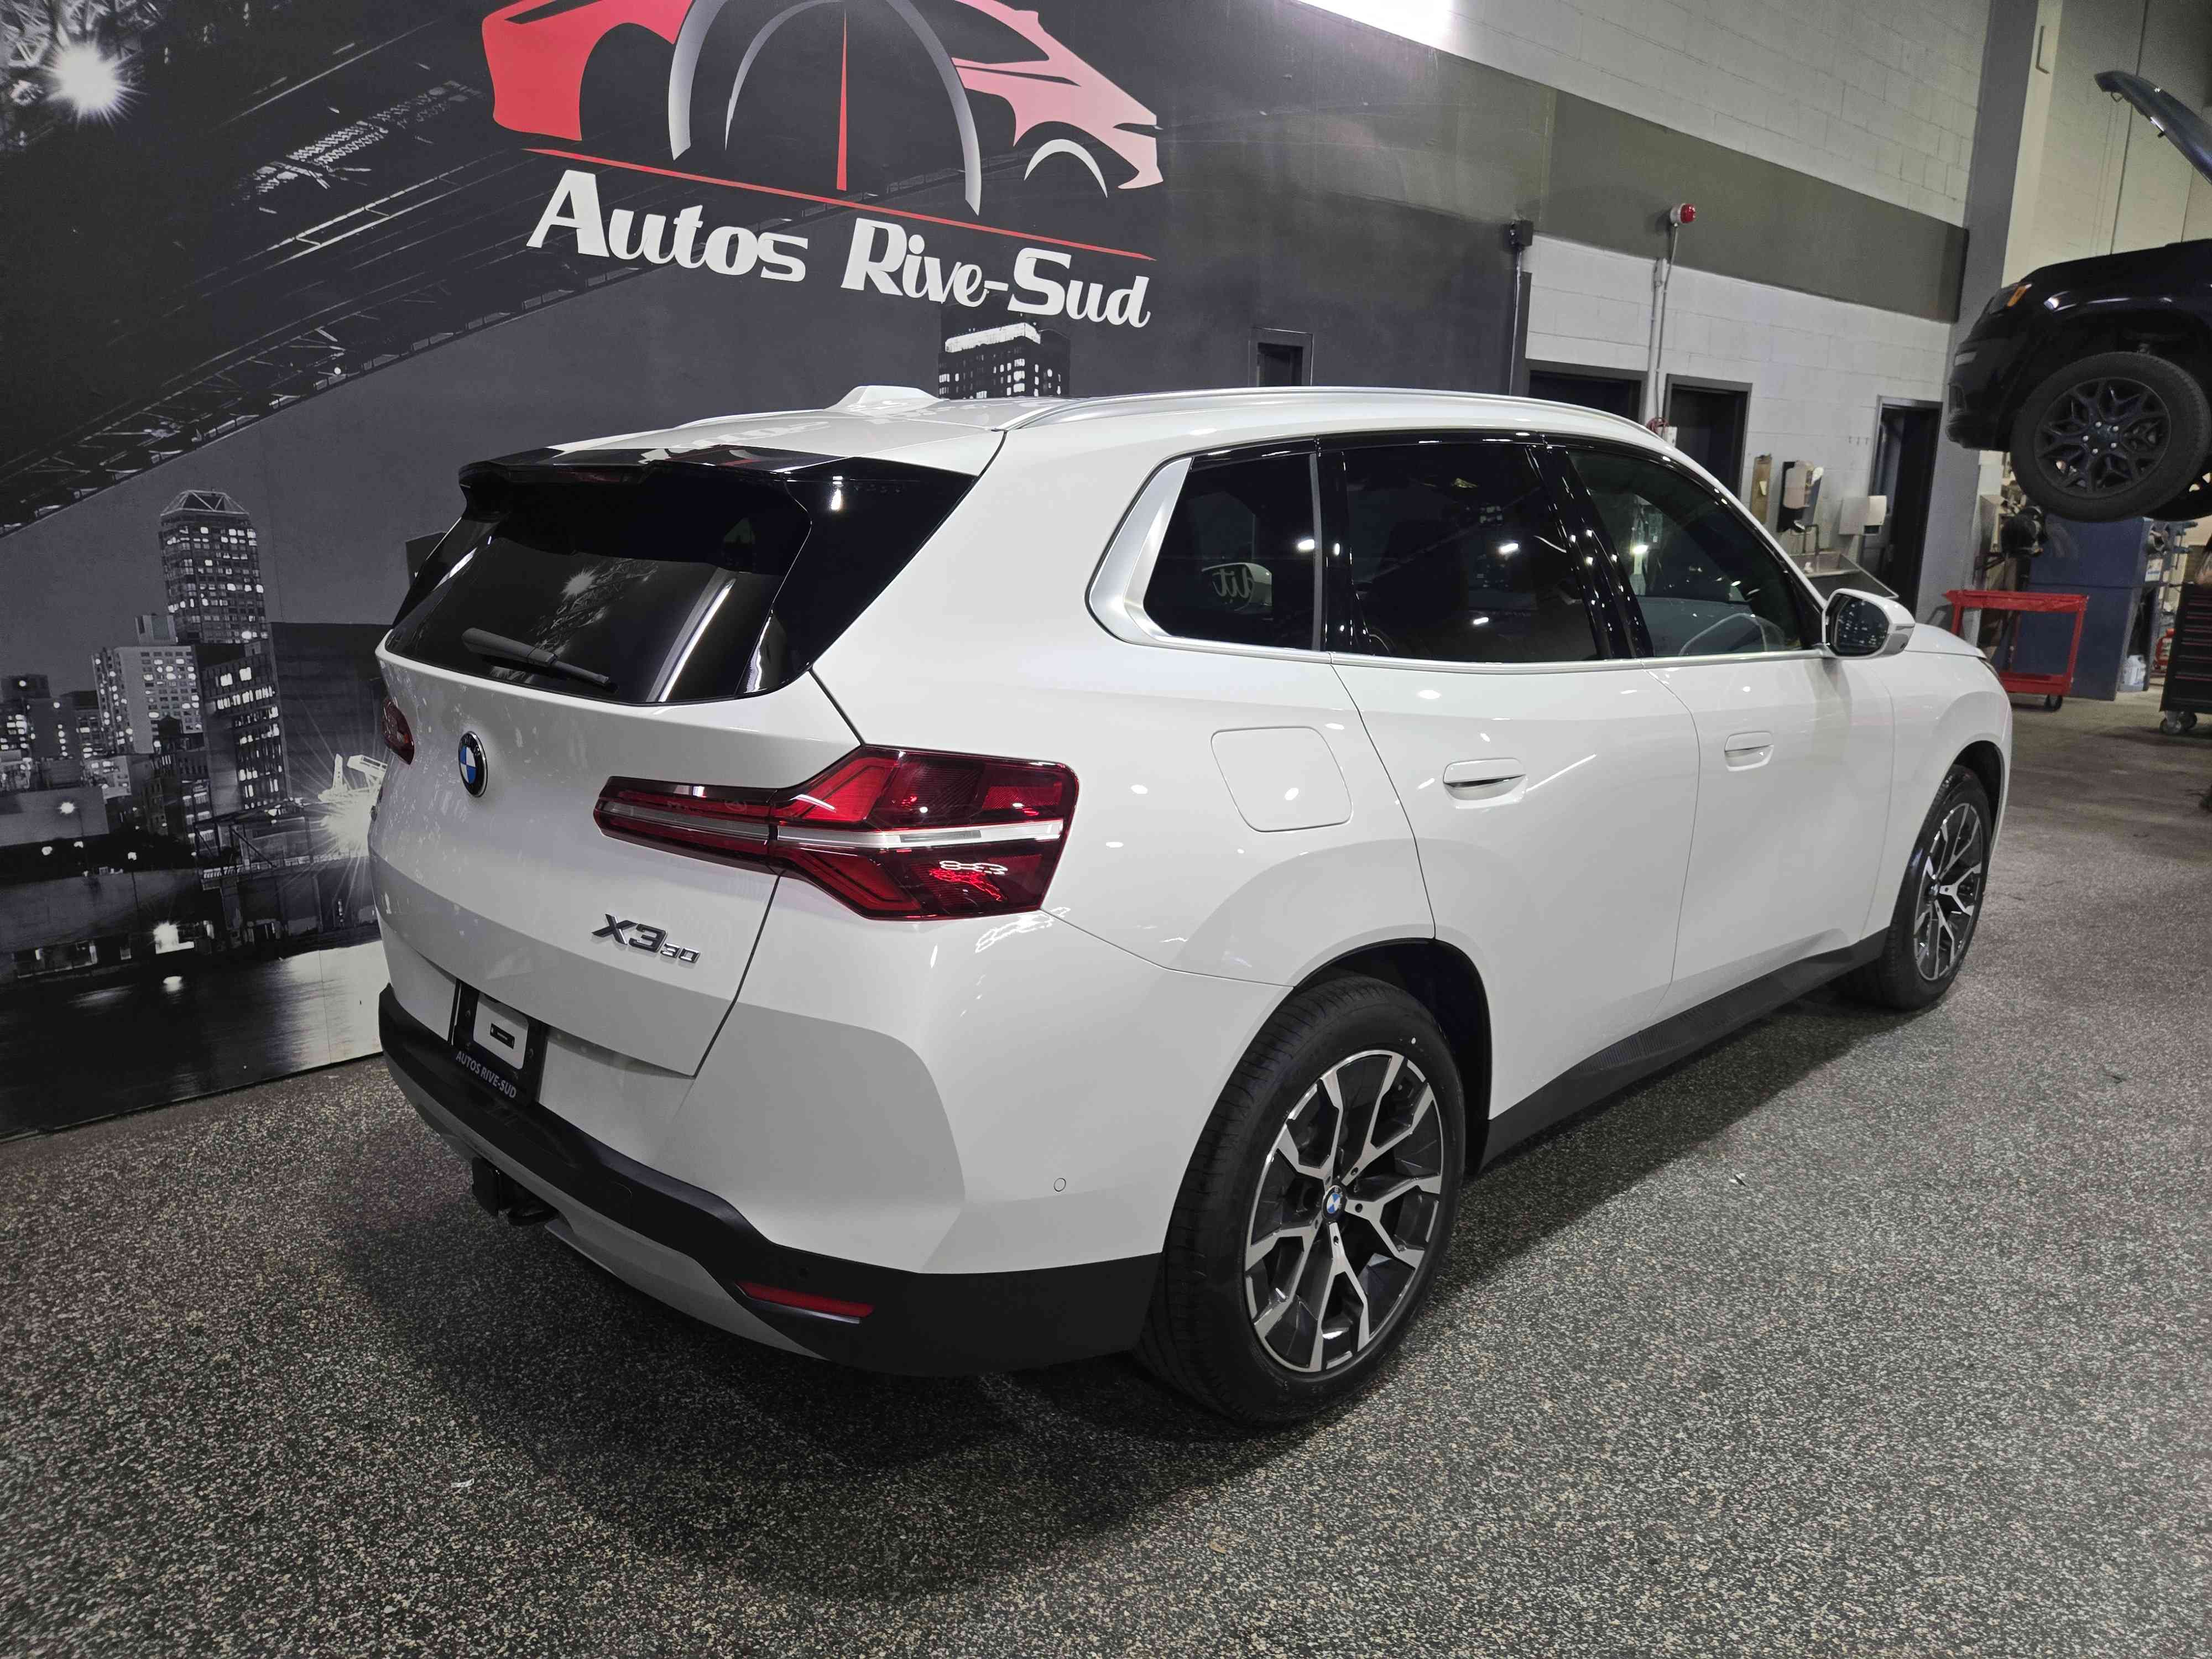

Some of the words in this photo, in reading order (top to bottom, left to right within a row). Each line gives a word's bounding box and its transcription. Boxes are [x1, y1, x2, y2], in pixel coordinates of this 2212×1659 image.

[526, 169, 808, 283] Autos
[841, 217, 1151, 328] Rive-Sud
[455, 1050, 481, 1074] AUTOS
[480, 1066, 517, 1098] RIVE-SUD
